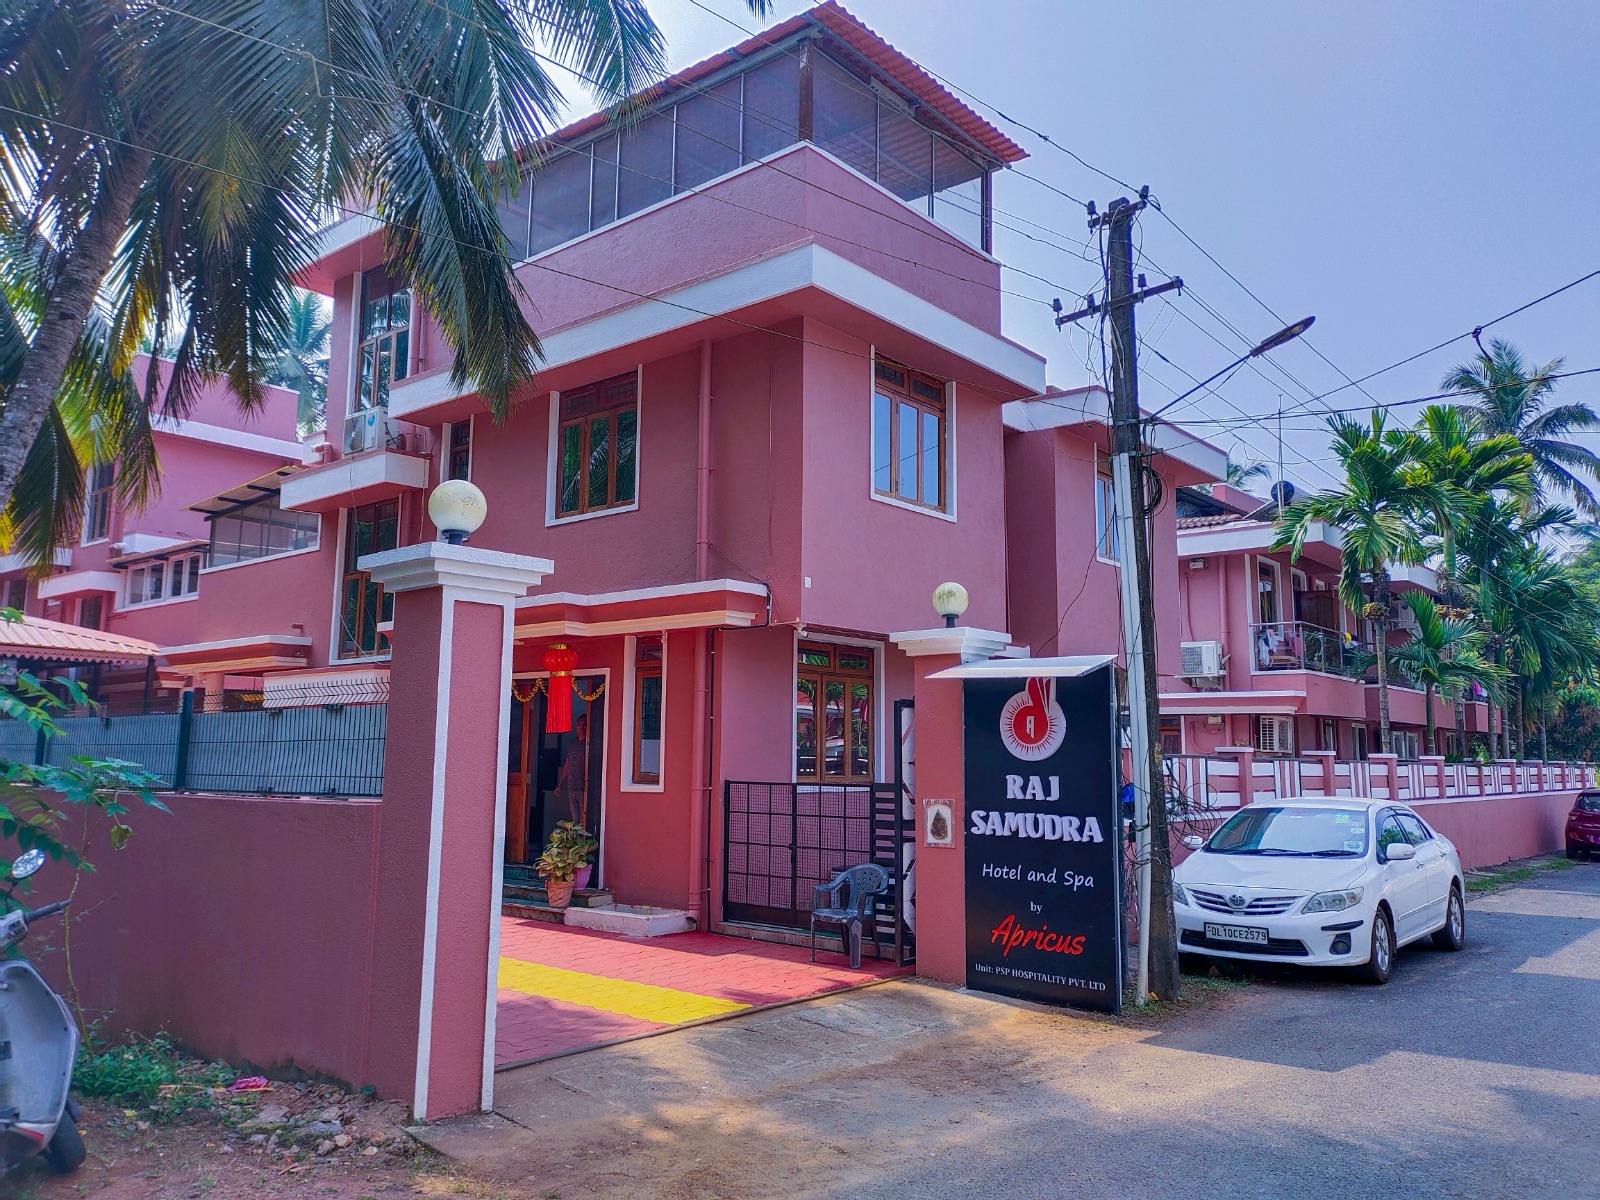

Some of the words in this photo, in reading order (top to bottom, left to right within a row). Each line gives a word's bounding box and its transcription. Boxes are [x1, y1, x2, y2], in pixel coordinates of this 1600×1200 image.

[1005, 774, 1060, 801] RAJ
[970, 810, 1104, 843] SAMUDRA
[982, 863, 1021, 880] Hotel
[1027, 868, 1057, 883] and
[1063, 871, 1095, 891] Spa
[1030, 902, 1043, 915] by
[990, 913, 1086, 957] Apricus
[1211, 926, 1267, 941] DL10CE2579
[975, 963, 994, 974] Unit:
[995, 967, 1010, 976] PSP
[1011, 969, 1067, 985] HOSPITALITY
[1068, 978, 1088, 989] PVT.
[1089, 980, 1106, 991] LTD
